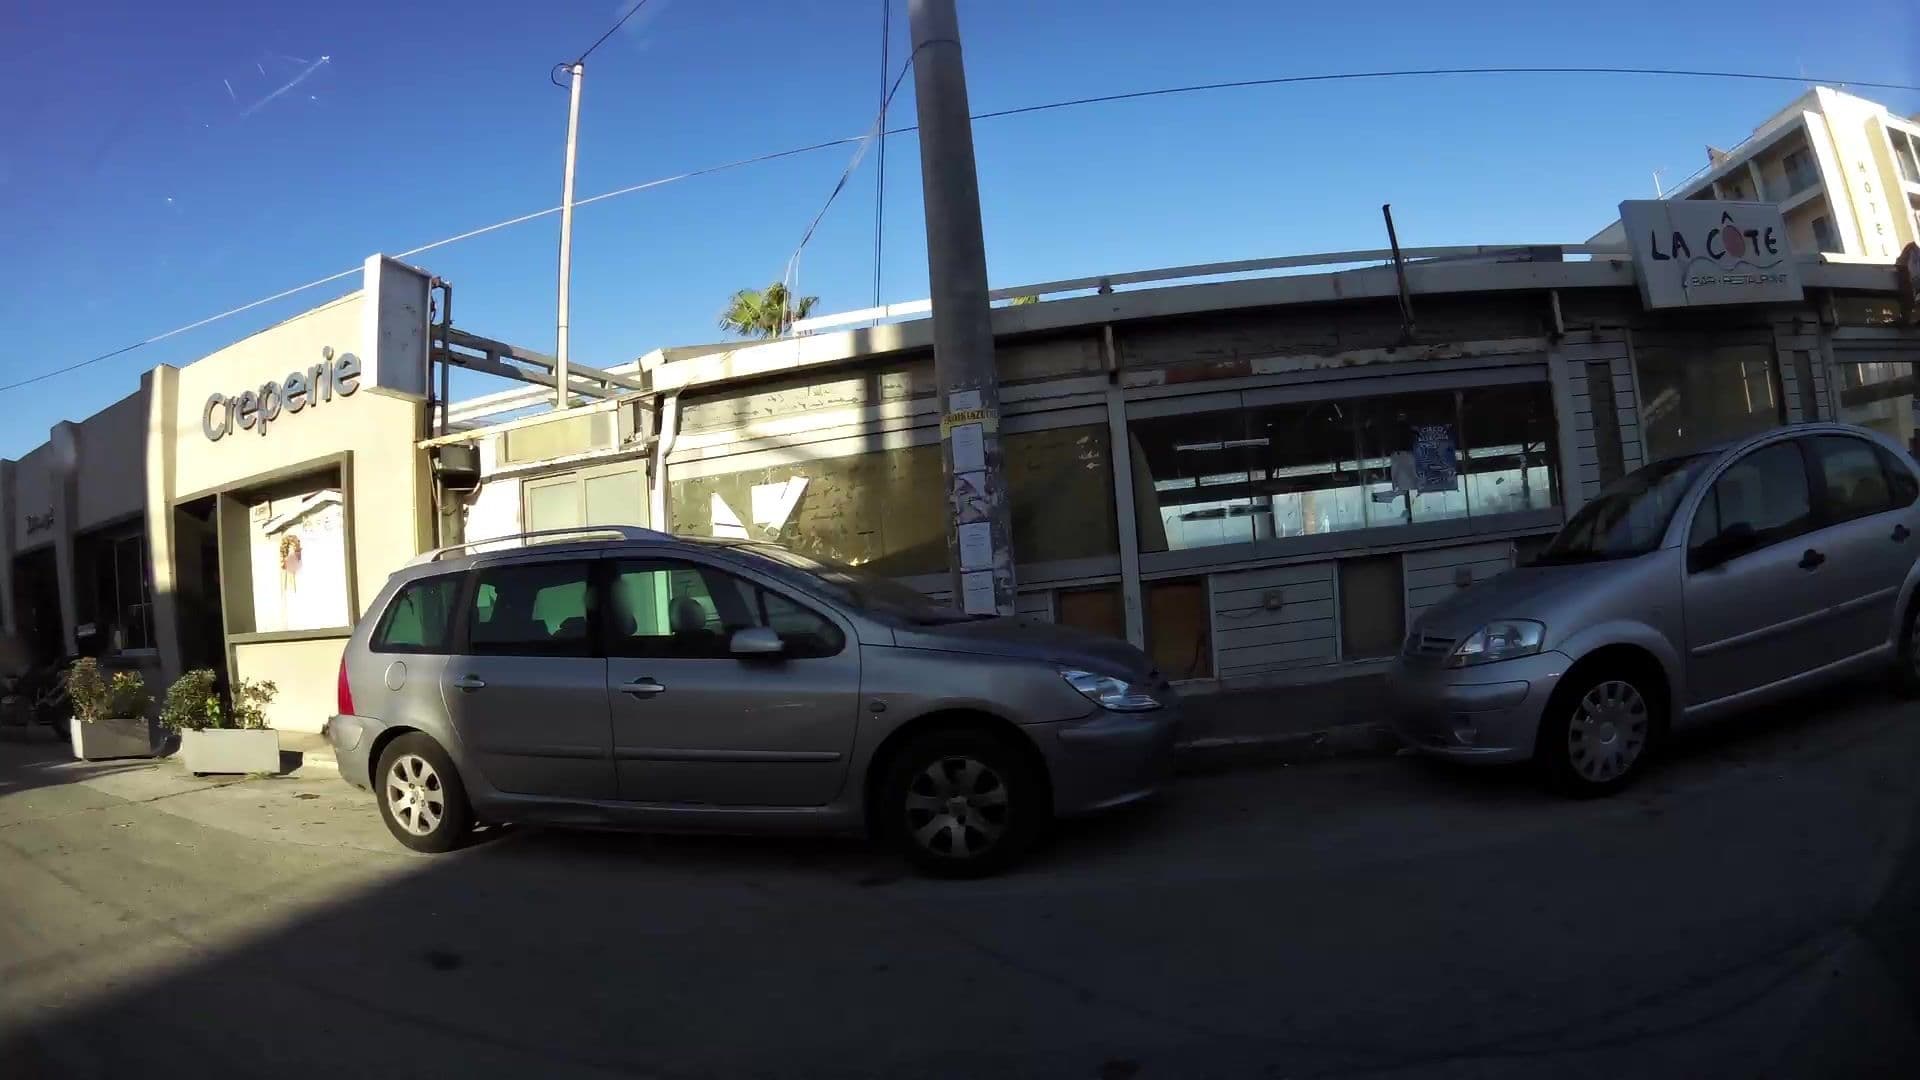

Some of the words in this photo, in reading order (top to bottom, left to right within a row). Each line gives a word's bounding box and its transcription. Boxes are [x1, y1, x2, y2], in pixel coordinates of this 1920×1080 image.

[1651, 229, 1691, 260] LA
[1706, 211, 1778, 260] CÔTE
[1857, 159, 1889, 257] HOTEL
[202, 345, 362, 442] Creperie
